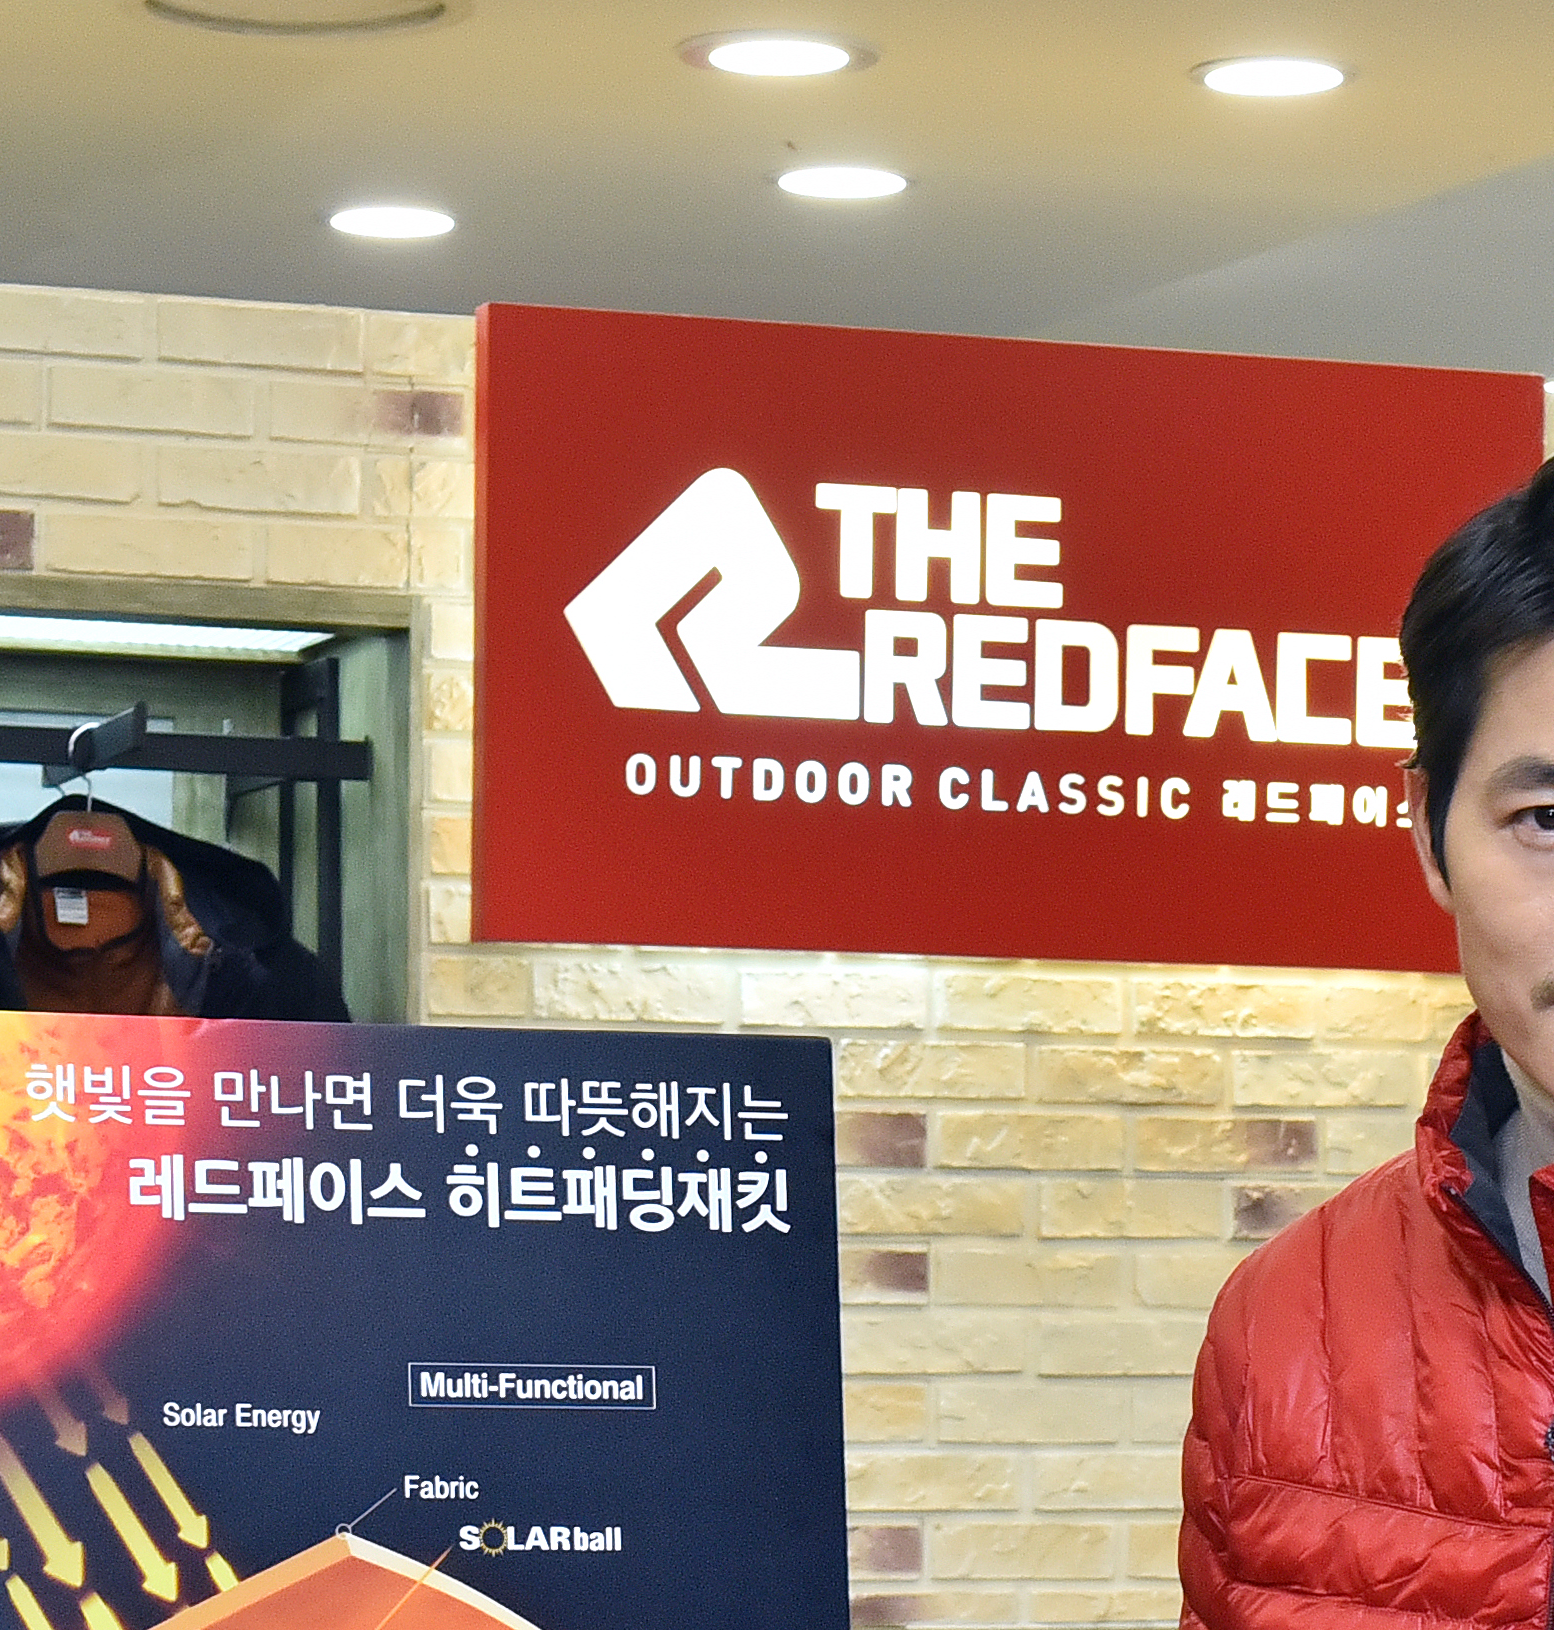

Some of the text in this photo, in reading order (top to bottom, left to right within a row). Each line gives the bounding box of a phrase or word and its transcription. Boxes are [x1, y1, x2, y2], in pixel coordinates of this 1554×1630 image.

[815, 482, 1063, 609] THE
[863, 608, 1418, 749] REDFACE
[625, 753, 1191, 820] OUTDOOR CLASSIC
[23, 1061, 791, 1144] 햇빛을 만나면 더욱 따뜻해지는
[128, 1152, 793, 1235] 레드페이스 히트패딩재킷
[162, 1402, 321, 1434] Solar Energy
[419, 1371, 644, 1402] Multi-Functional
[403, 1474, 480, 1501] Fabric
